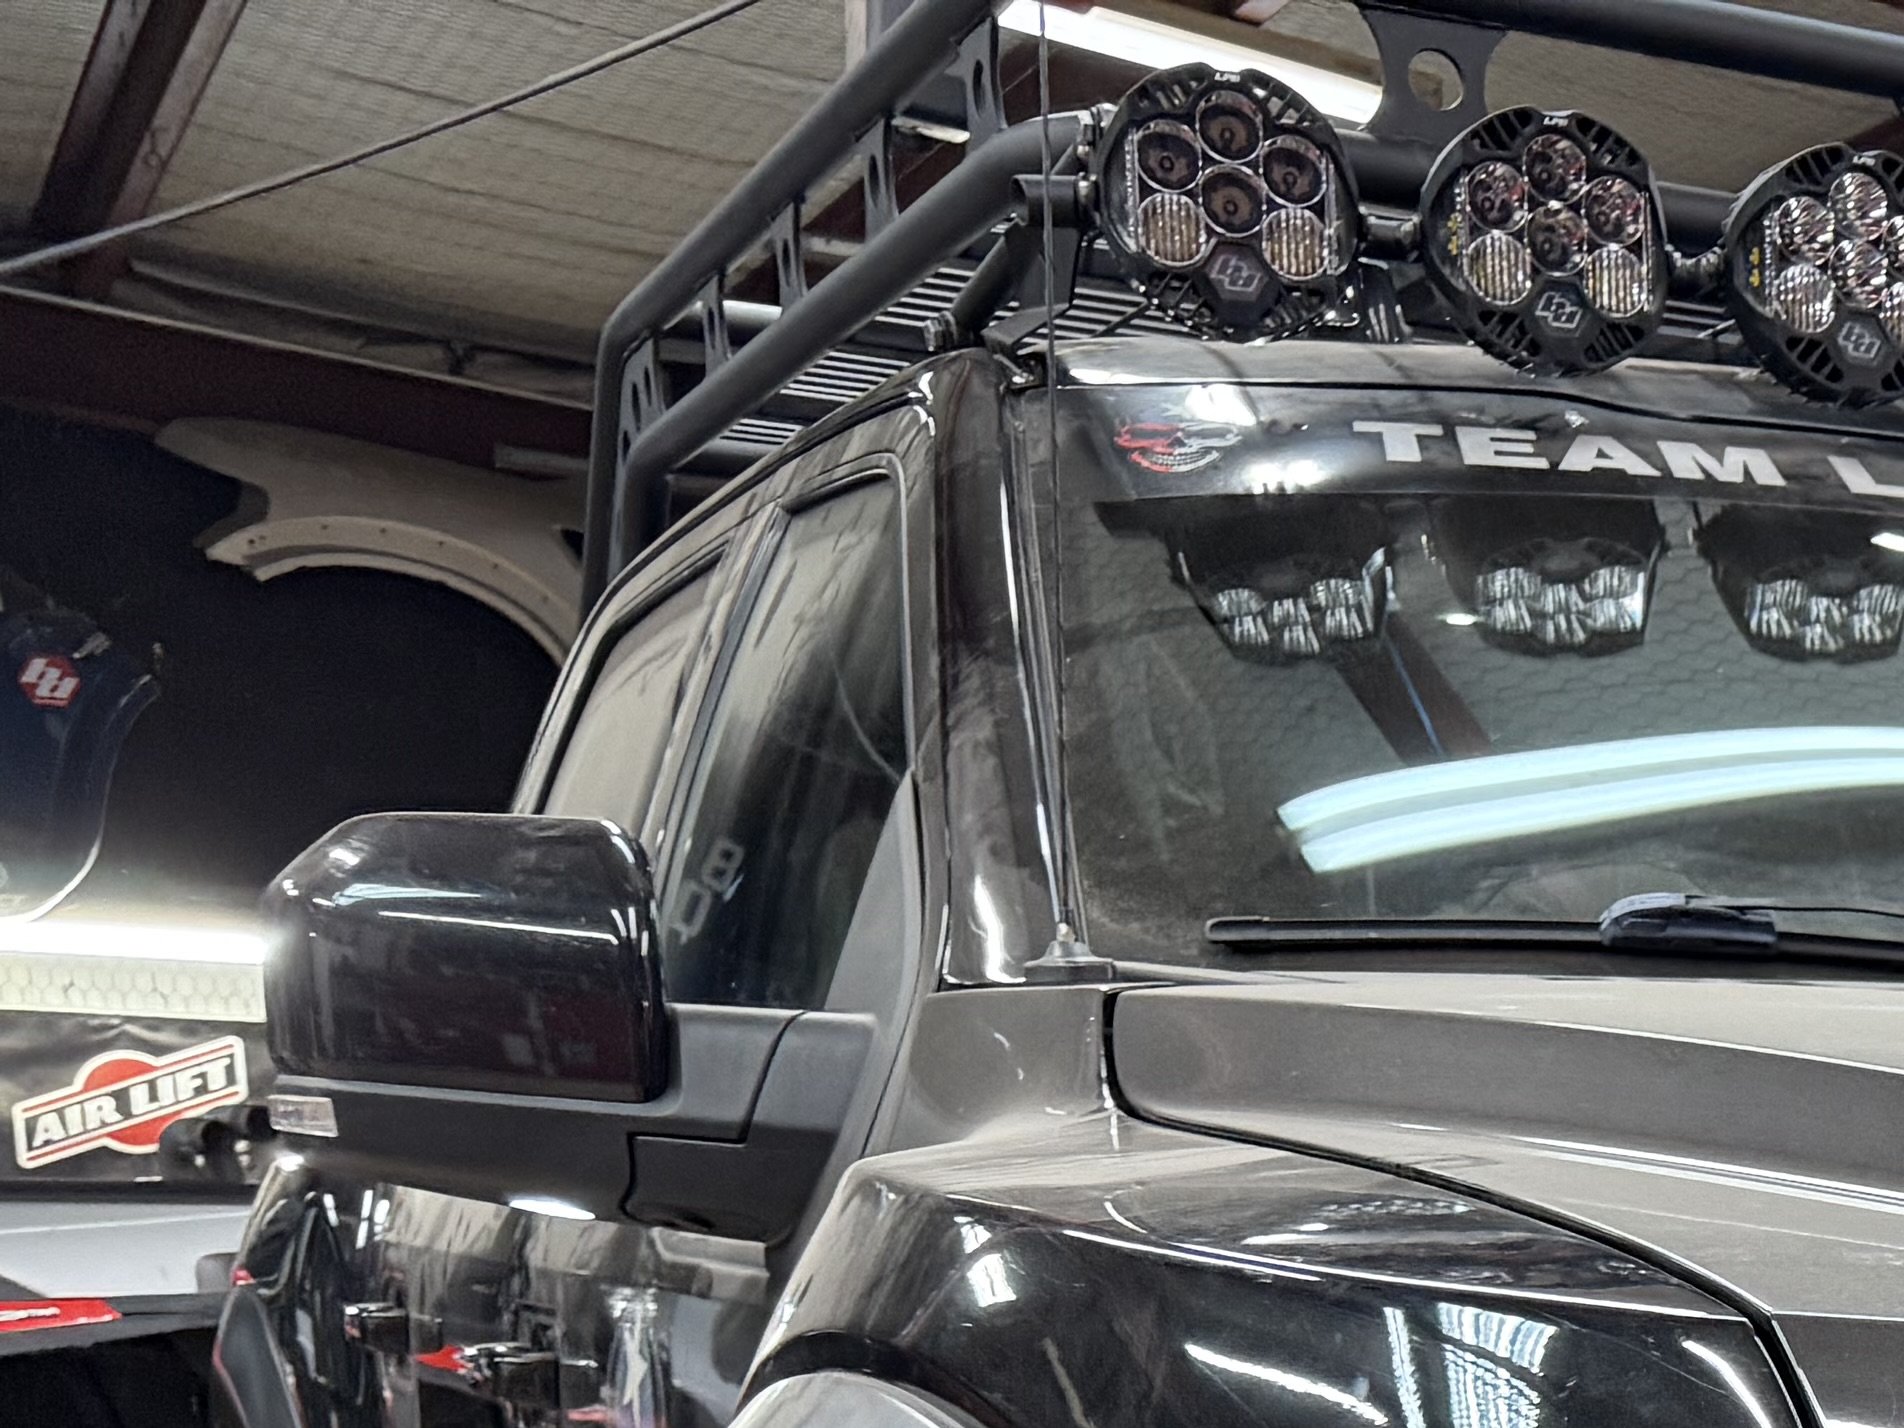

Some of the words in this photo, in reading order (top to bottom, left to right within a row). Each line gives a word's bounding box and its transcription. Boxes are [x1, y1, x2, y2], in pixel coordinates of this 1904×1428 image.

[1352, 419, 1787, 487] TEAM
[32, 1095, 125, 1148] AIR
[129, 1056, 232, 1116] LIFT
